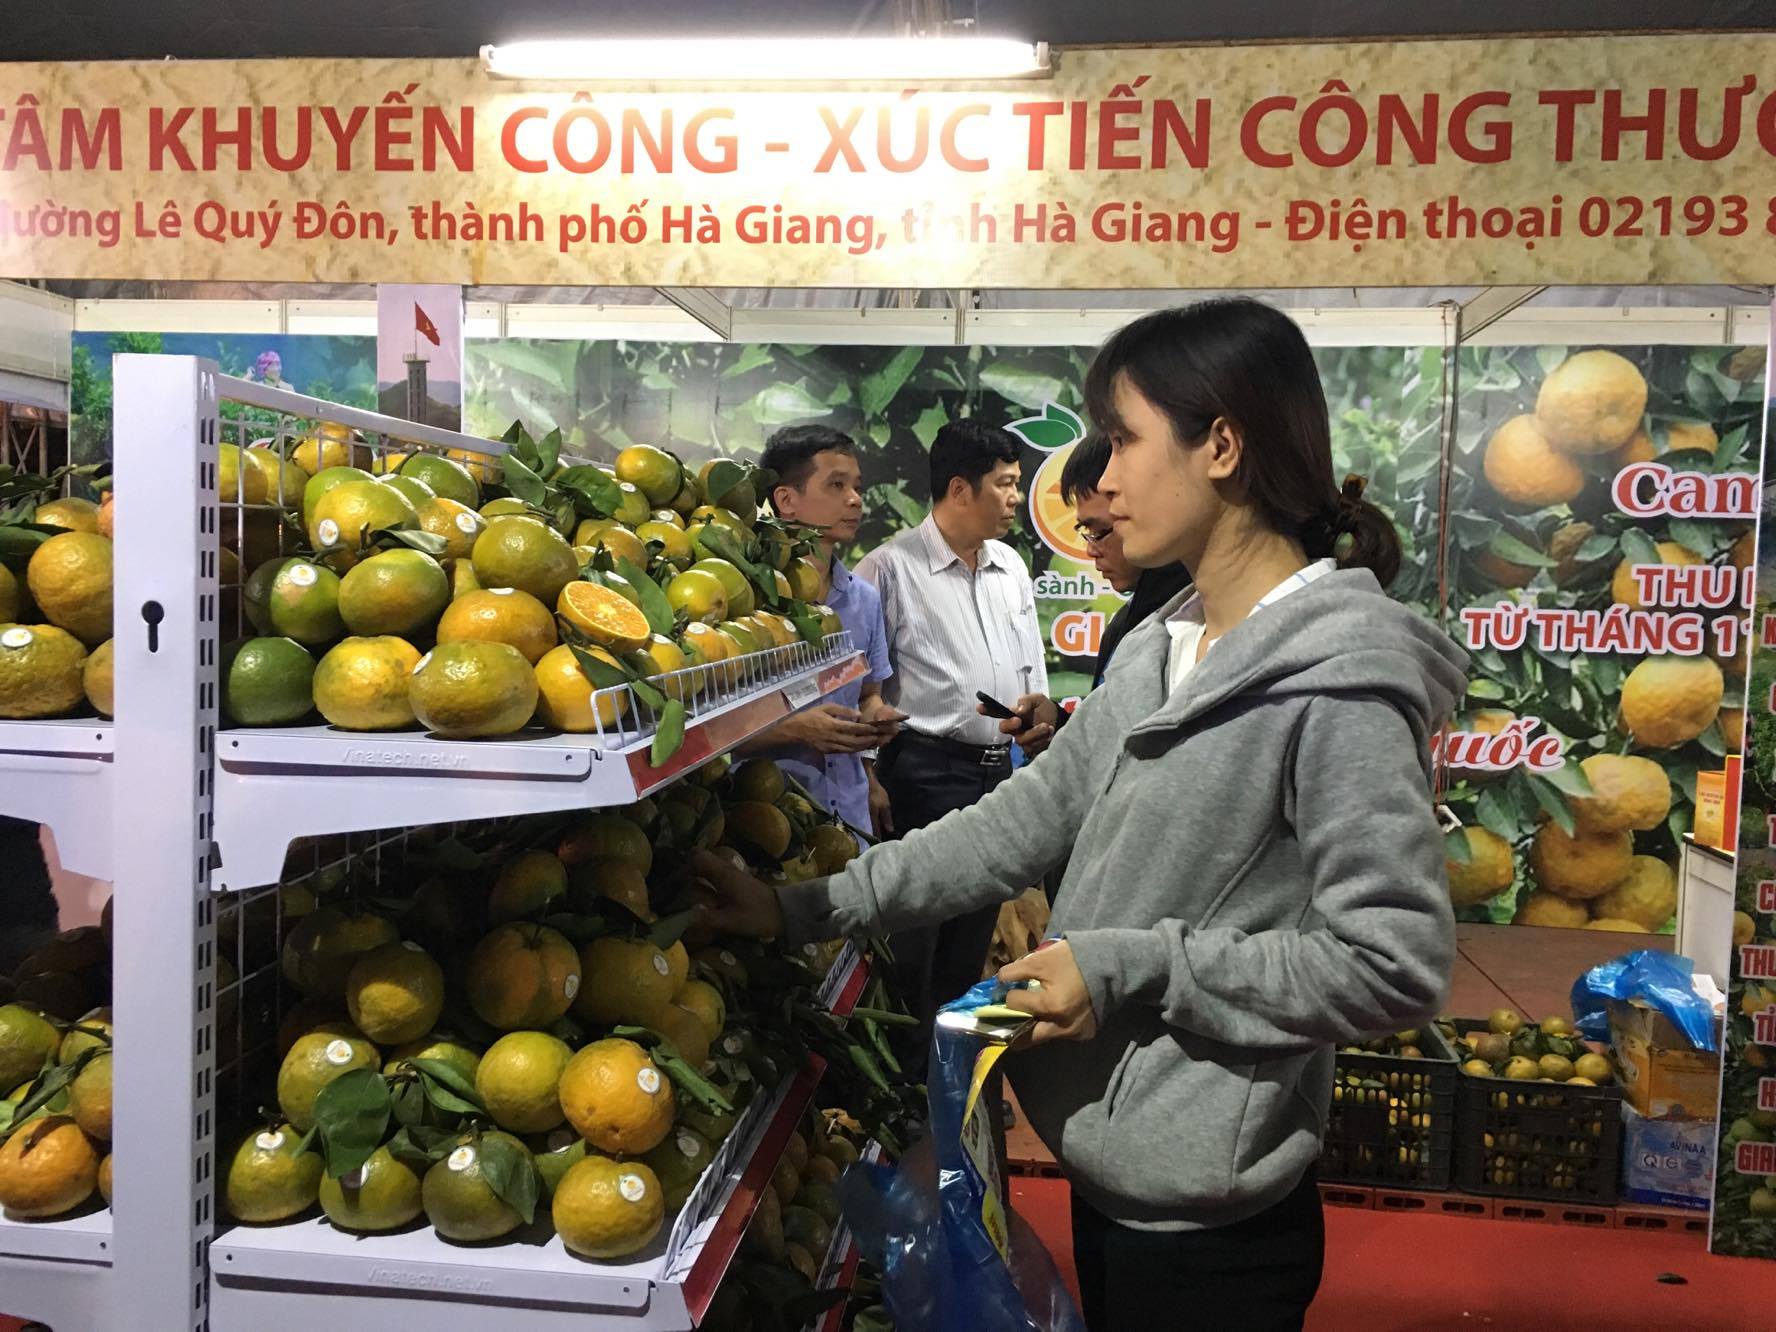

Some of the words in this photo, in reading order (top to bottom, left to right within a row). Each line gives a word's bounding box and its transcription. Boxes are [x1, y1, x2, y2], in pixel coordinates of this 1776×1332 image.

[148, 83, 475, 173] KHUYẾN
[500, 91, 738, 175] CÔNG
[813, 88, 991, 174] XÚC
[1013, 75, 1212, 171] TIẾN
[1239, 79, 1513, 169] CÔNG
[0, 199, 121, 249] ường
[134, 199, 182, 239] Lê
[193, 199, 284, 249] Quý
[293, 200, 399, 247] Đôn,
[411, 201, 545, 242] thành
[559, 199, 649, 254] phố
[662, 204, 722, 245] Hà
[735, 204, 890, 256] Giang,
[1014, 201, 1077, 243] Hà
[1092, 202, 1240, 254] Giang
[1284, 197, 1407, 253] Điện
[1423, 196, 1563, 250] thoại
[1579, 195, 1749, 238] 02193
[1037, 574, 1094, 596] sành
[1636, 568, 1731, 604] THU
[1465, 604, 1530, 646] TỪ
[1536, 607, 1699, 651] THÁNG
[1430, 720, 1562, 767] uốc
